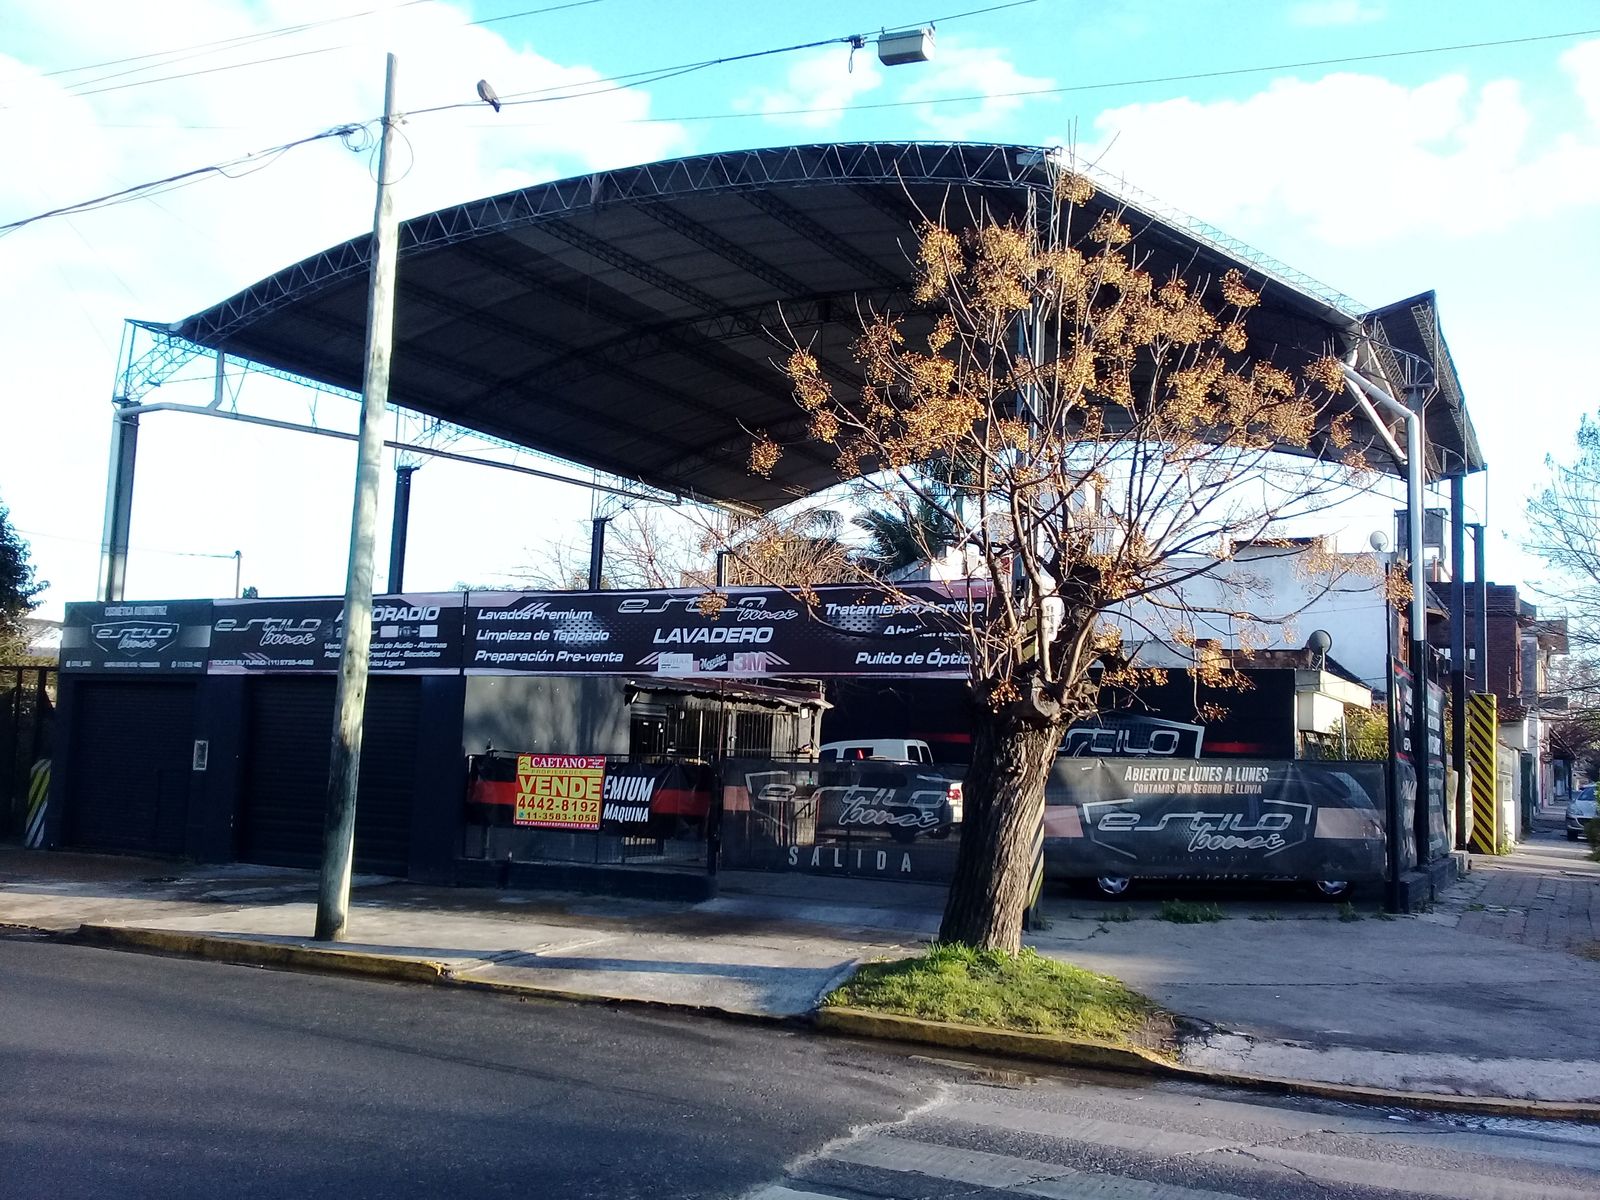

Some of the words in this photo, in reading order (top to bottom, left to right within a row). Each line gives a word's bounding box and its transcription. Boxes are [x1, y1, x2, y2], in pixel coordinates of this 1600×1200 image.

[477, 609, 531, 620] Lavados
[533, 608, 592, 620] Premium
[476, 629, 531, 643] Limpieza
[533, 630, 550, 640] de
[552, 629, 609, 643] Tapizado
[653, 626, 774, 644] LAVADERO
[474, 650, 554, 663] Preparación
[556, 651, 624, 662] Pre-venta
[734, 653, 766, 671] 3M
[855, 651, 902, 665] Pulido
[904, 651, 924, 665] de
[532, 757, 587, 769] CAETANO
[1124, 765, 1170, 781] ABIERTO
[1172, 767, 1186, 781] DE
[1188, 765, 1223, 782] LUNES
[1224, 767, 1233, 781] A
[1235, 767, 1270, 782] LUNES
[518, 776, 602, 800] VENDE
[1133, 783, 1175, 794] CONTAMOS
[1176, 783, 1192, 794] CON
[1193, 783, 1223, 794] SEGURO
[1224, 783, 1235, 794] DE
[1235, 783, 1262, 794] LLUVIA
[518, 795, 597, 813] 4442-8192
[603, 803, 649, 823] MAQUINA
[788, 846, 912, 873] SALIDA
